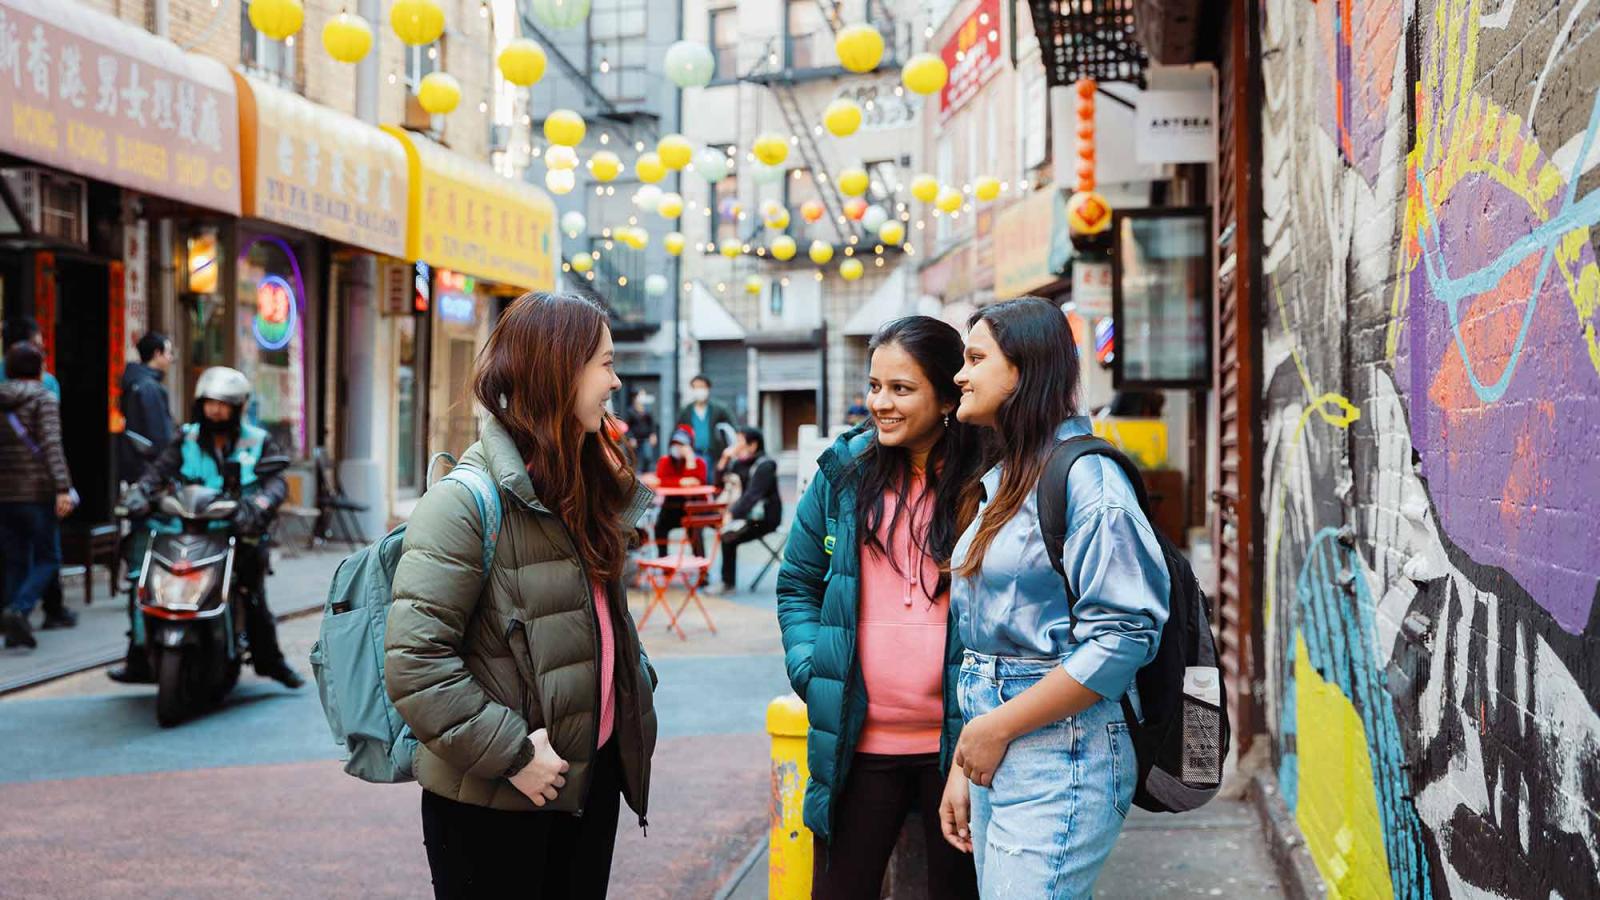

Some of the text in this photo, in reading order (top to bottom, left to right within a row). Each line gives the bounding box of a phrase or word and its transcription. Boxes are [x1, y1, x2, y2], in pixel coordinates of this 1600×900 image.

[12, 101, 207, 188] HONG KONG BARBER SHOP
[312, 192, 350, 225] HAIR
